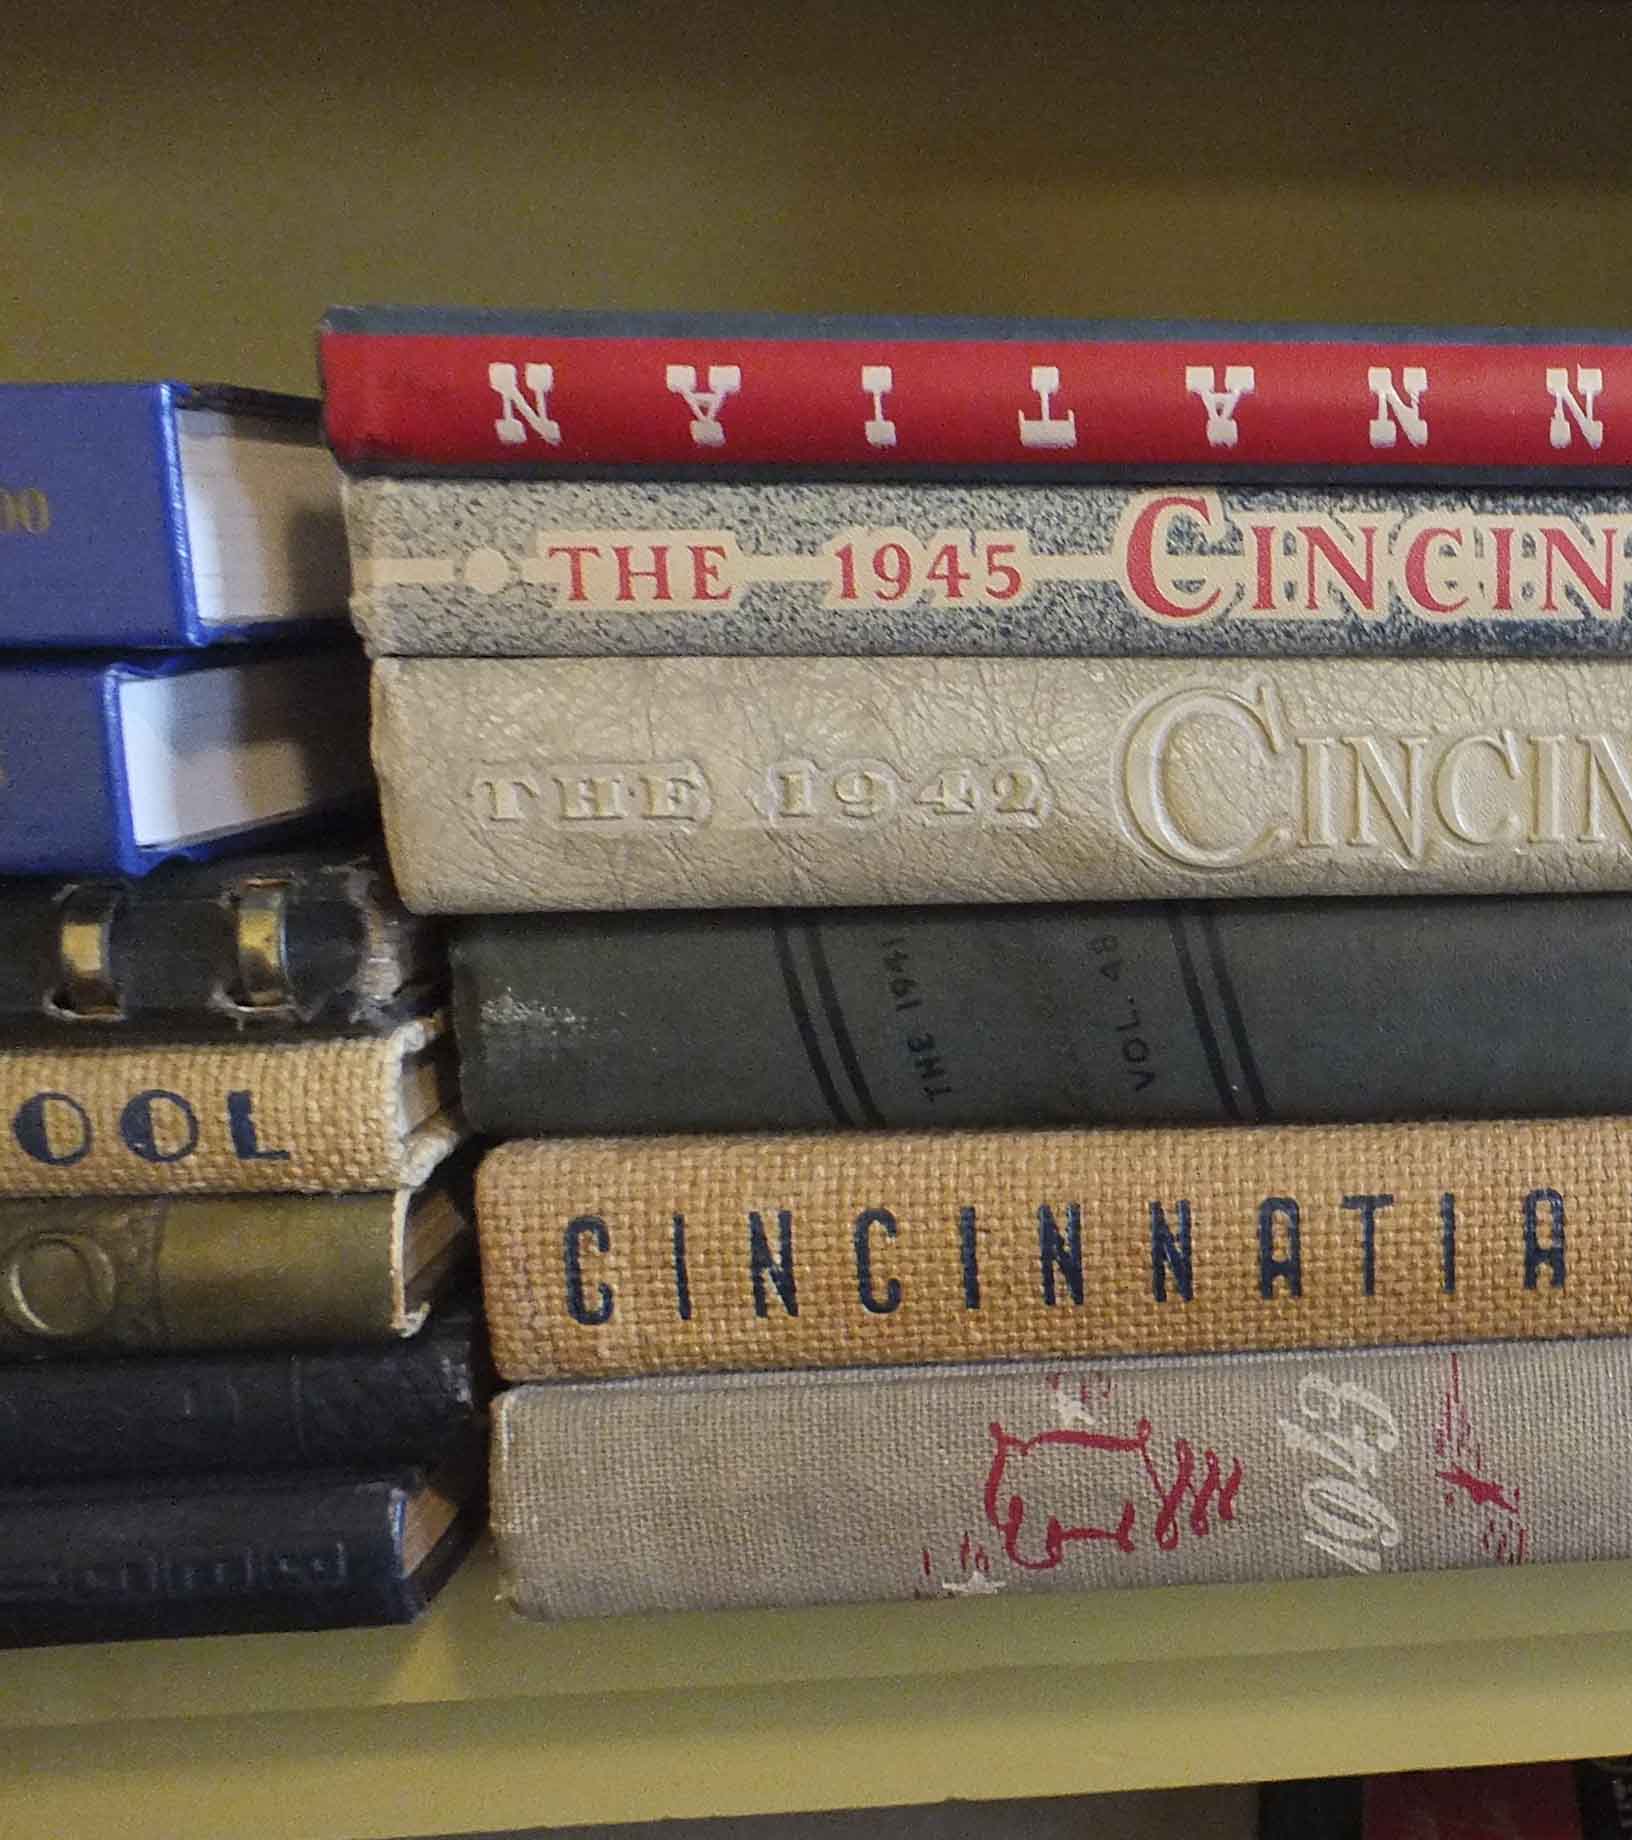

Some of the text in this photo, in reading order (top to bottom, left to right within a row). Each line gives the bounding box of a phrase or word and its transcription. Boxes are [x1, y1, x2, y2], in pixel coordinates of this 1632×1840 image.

[547, 542, 736, 602] THE
[832, 542, 1023, 602] 1945
[474, 768, 705, 823] THE
[772, 766, 1046, 828] 1942
[879, 936, 952, 1102] THE 1941
[14, 1087, 290, 1165] OOL
[1278, 1371, 1401, 1574] 1943
